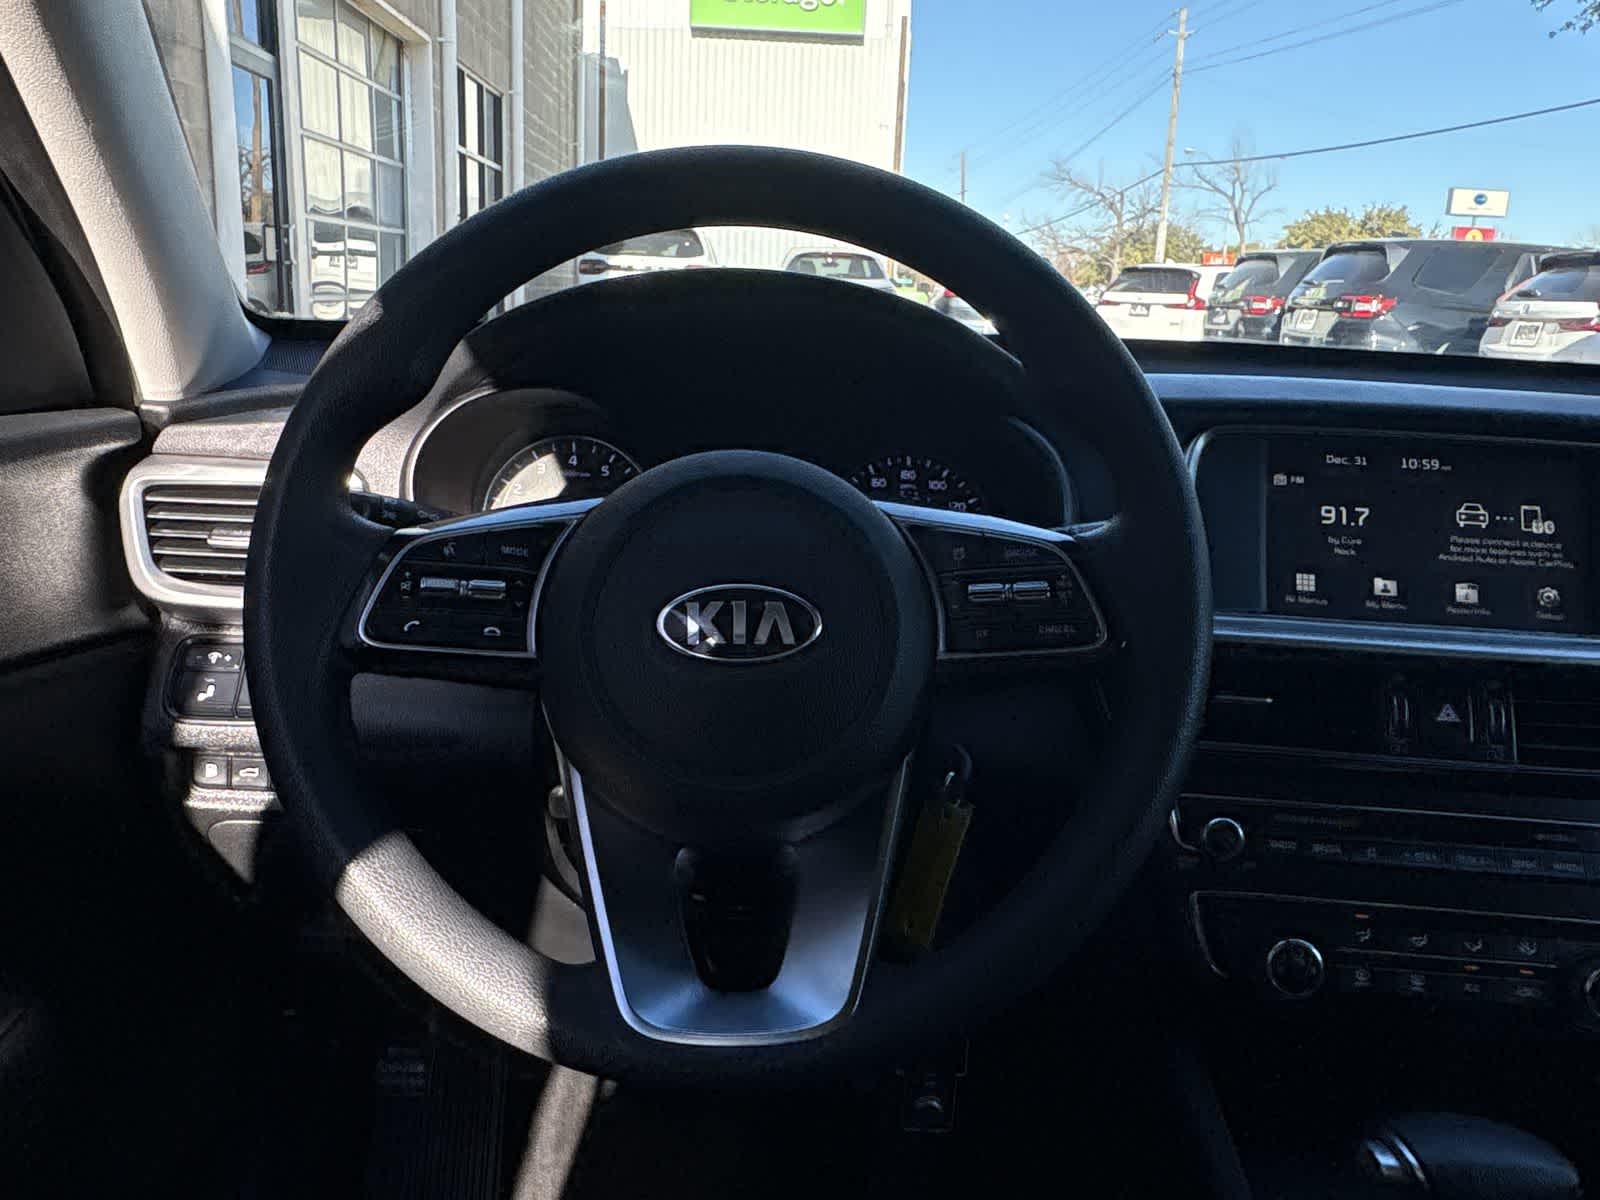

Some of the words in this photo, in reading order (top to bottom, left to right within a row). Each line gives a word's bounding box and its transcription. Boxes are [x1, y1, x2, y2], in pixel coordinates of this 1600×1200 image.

[568, 455, 578, 467] 4
[1354, 456, 1368, 466] 31
[1401, 457, 1440, 471] 10:59
[536, 463, 546, 474] 3
[600, 465, 610, 477] 5
[928, 480, 948, 491] 100
[1320, 505, 1371, 527] 91.7
[685, 600, 796, 646] KIA
